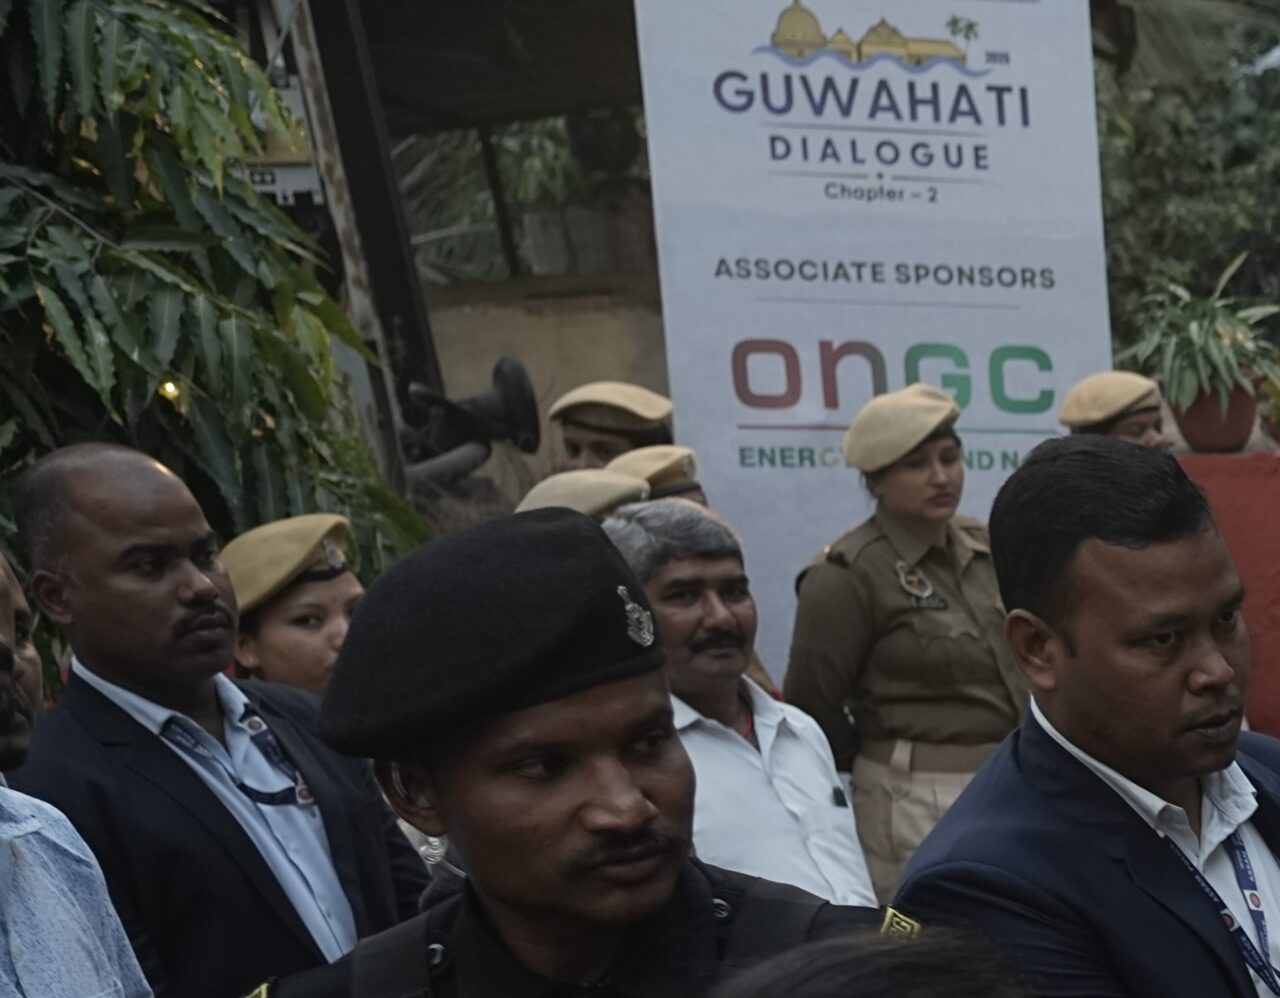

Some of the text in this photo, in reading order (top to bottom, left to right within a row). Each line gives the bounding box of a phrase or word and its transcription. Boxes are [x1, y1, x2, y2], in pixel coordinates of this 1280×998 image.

[713, 70, 1030, 127] GUWAHATI
[769, 135, 989, 170] DIALOGUE
[824, 182, 904, 203] Chapter
[928, 187, 938, 203] 2
[715, 257, 1056, 289] ASSOCIATE SPONSORS
[738, 446, 844, 470] ENERG
